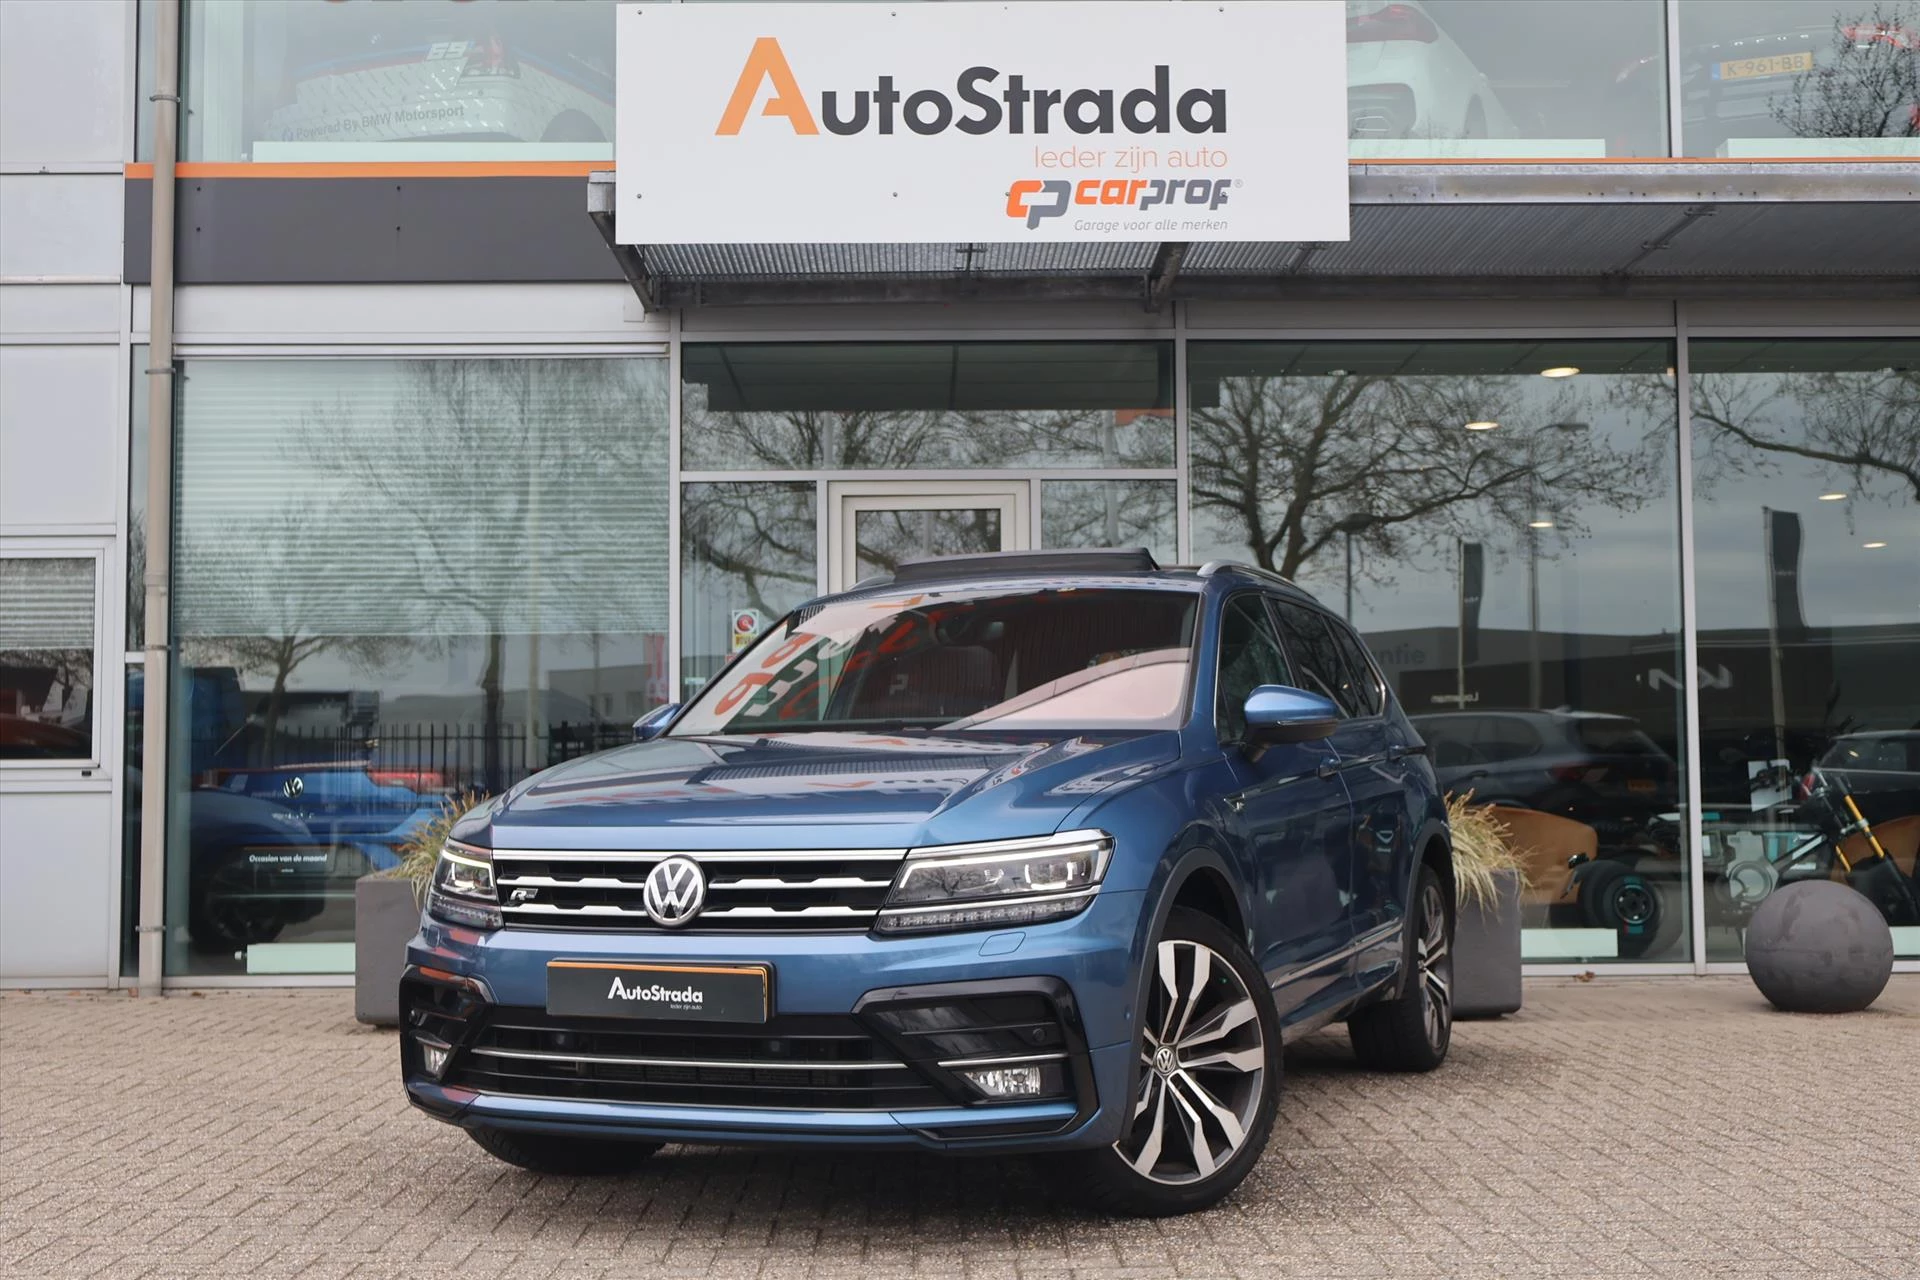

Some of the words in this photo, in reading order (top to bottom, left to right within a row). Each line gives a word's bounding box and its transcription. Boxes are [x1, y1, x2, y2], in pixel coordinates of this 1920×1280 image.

[1728, 55, 1805, 76] K-961-BB
[714, 36, 1227, 136] AutoStrada
[296, 119, 341, 139] Powered
[343, 117, 358, 132] By
[362, 112, 392, 129] BMW
[395, 105, 465, 123] Motorsport
[1034, 146, 1107, 168] Ieder
[1114, 146, 1158, 174] zijn
[1167, 148, 1228, 168] auto
[1074, 219, 1119, 233] Garage
[1123, 221, 1152, 231] voor
[1154, 218, 1177, 231] alle
[1181, 218, 1228, 231] merken
[248, 853, 279, 863] Occasion
[279, 855, 293, 863] van
[293, 853, 303, 862] de
[302, 853, 328, 863] maand
[607, 976, 704, 1003] AutoStrada
